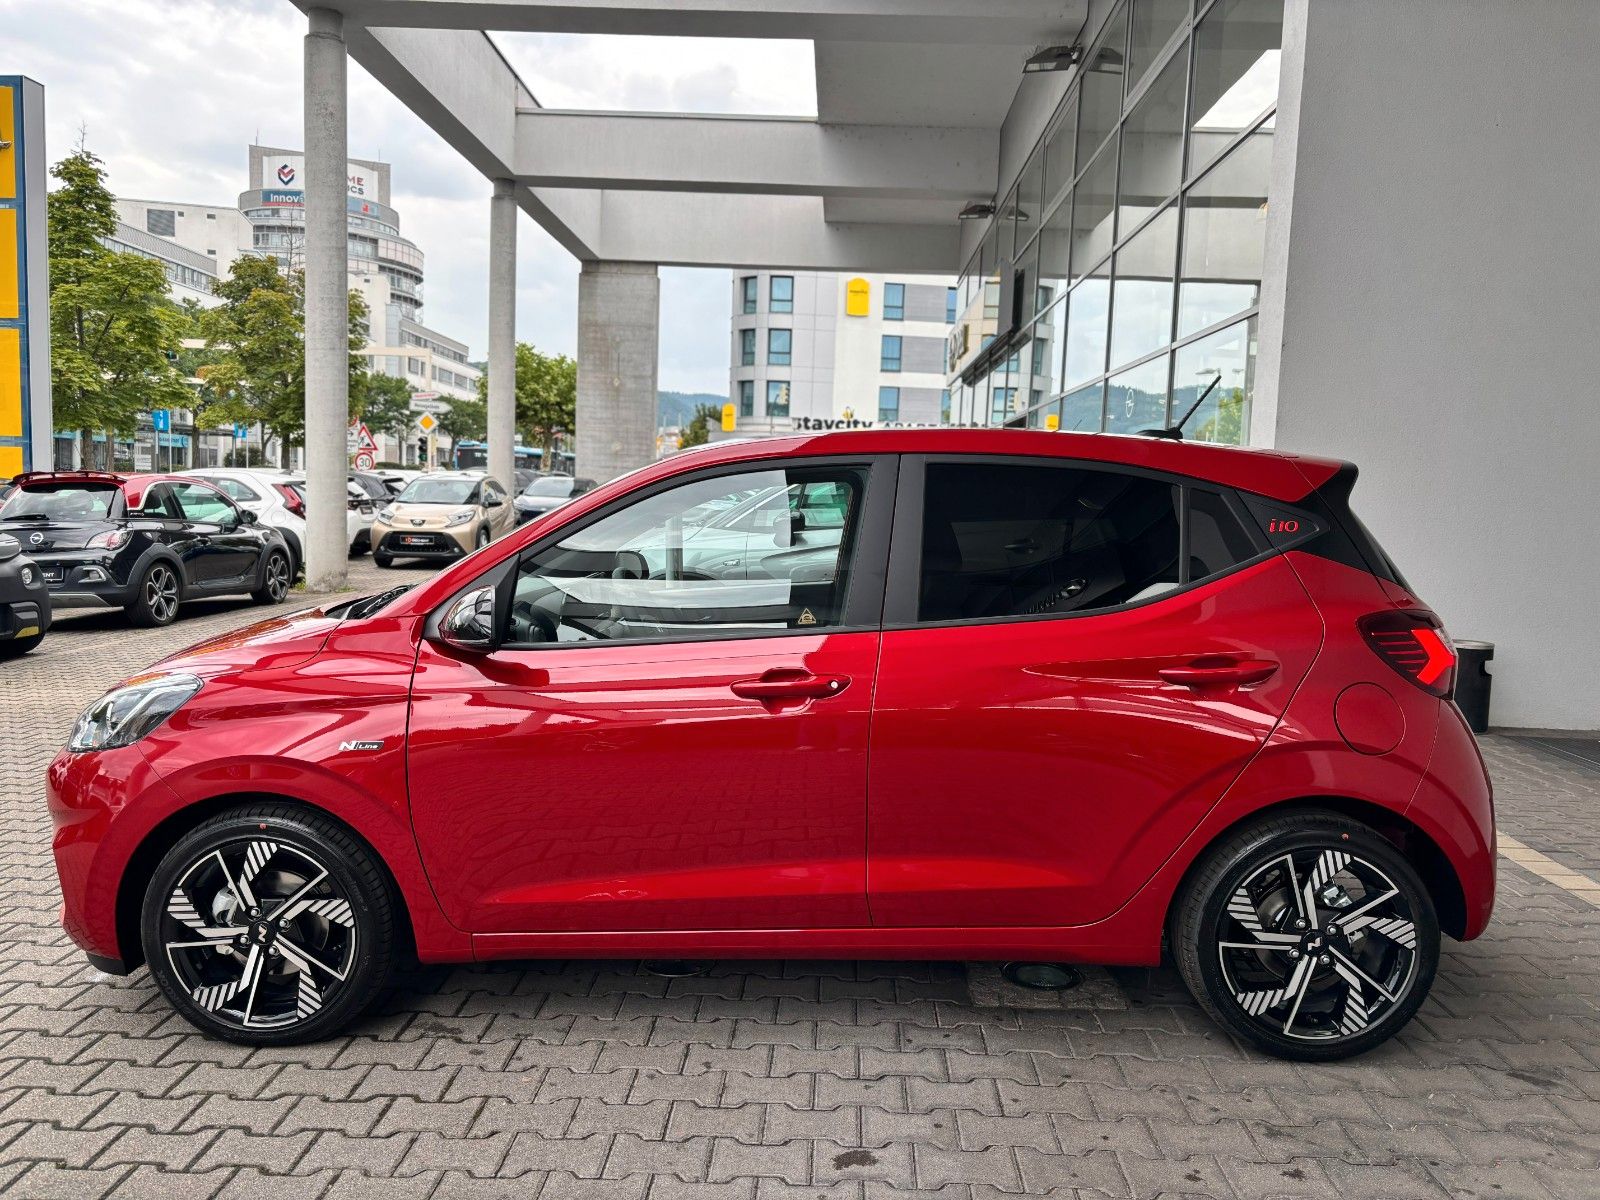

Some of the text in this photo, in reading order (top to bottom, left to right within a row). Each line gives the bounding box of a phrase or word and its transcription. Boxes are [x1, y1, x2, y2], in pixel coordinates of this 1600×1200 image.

[359, 457, 371, 468] 30
[1269, 518, 1299, 533] i10
[338, 740, 357, 751] N
